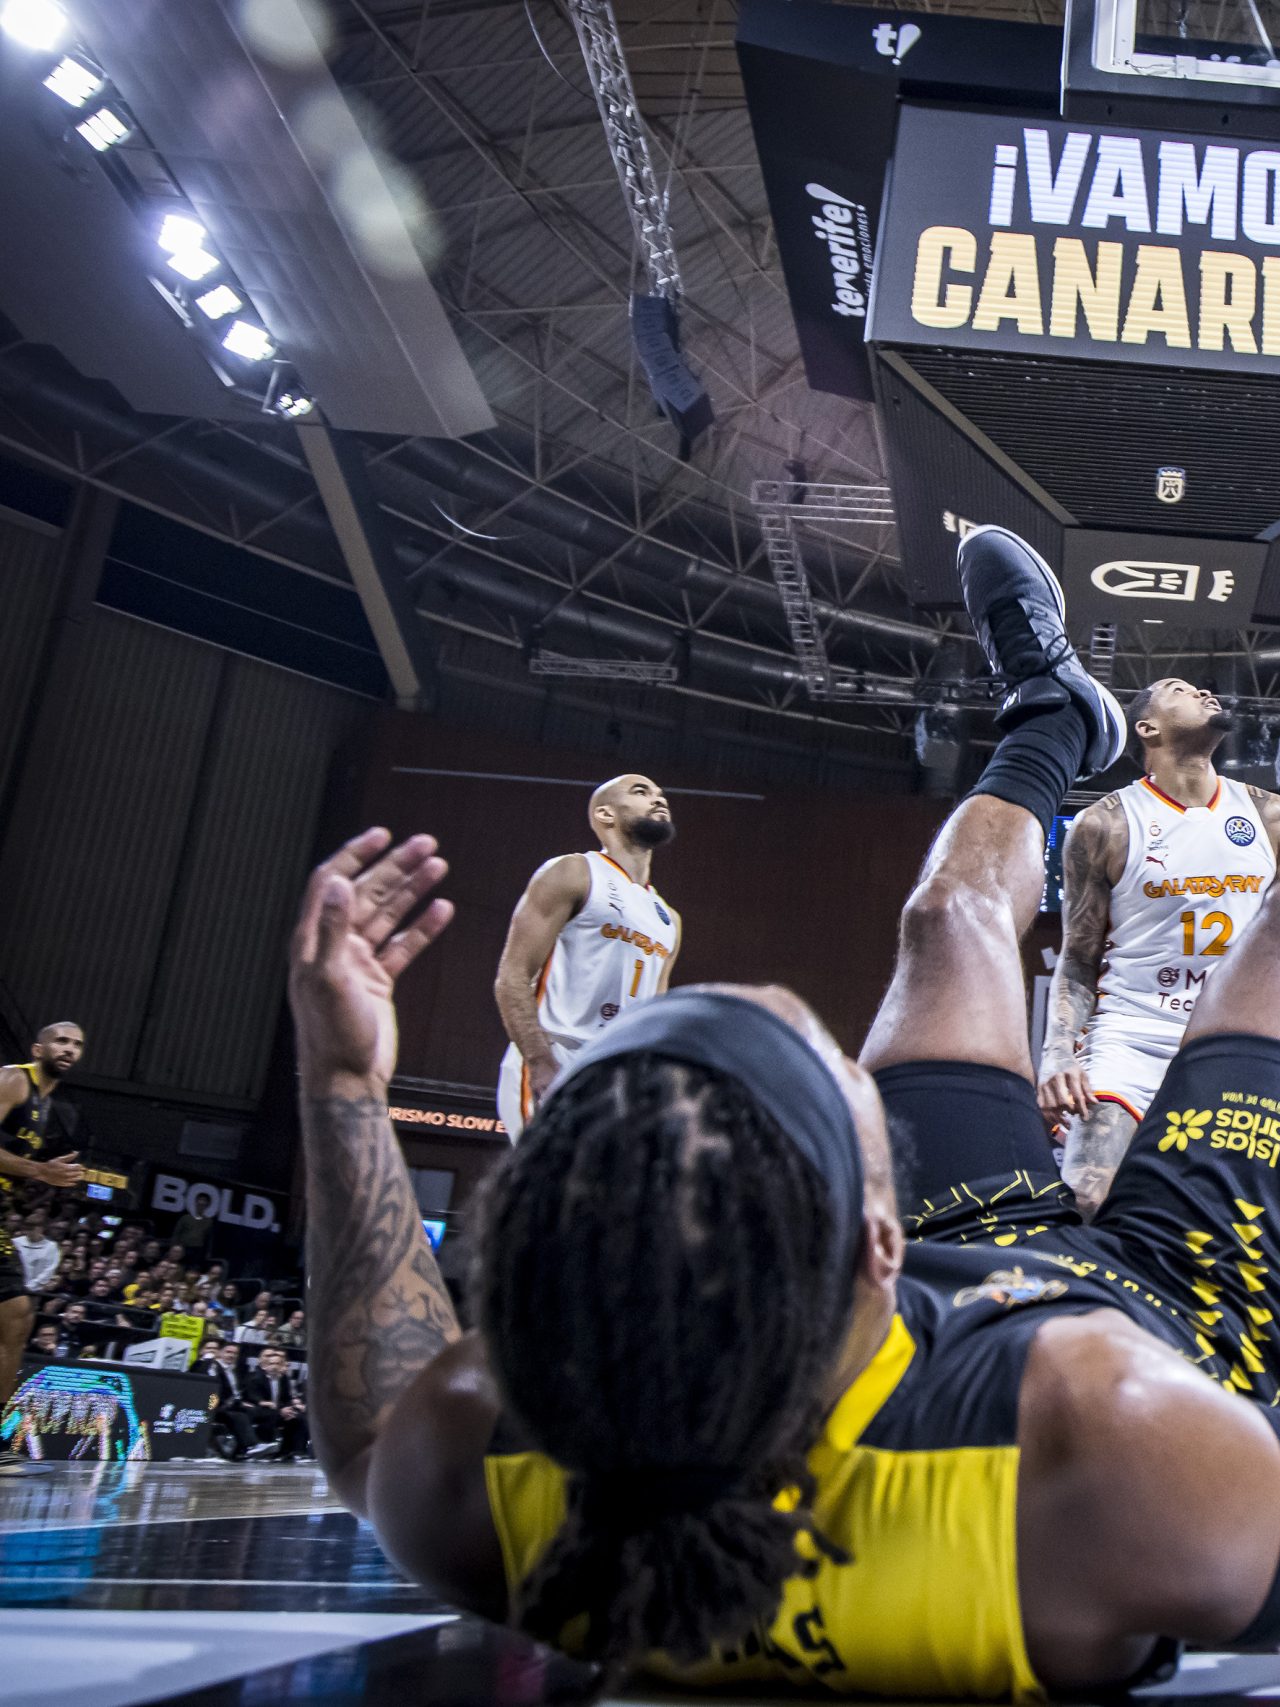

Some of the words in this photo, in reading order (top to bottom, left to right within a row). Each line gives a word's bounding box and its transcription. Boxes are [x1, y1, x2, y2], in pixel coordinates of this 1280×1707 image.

[1143, 874, 1266, 898] GALATASARAY
[1180, 910, 1234, 956] 12
[629, 958, 645, 998] 1
[388, 1106, 446, 1126] RISMO
[446, 1113, 495, 1132] SLOW
[151, 1173, 281, 1233] BOLD.
